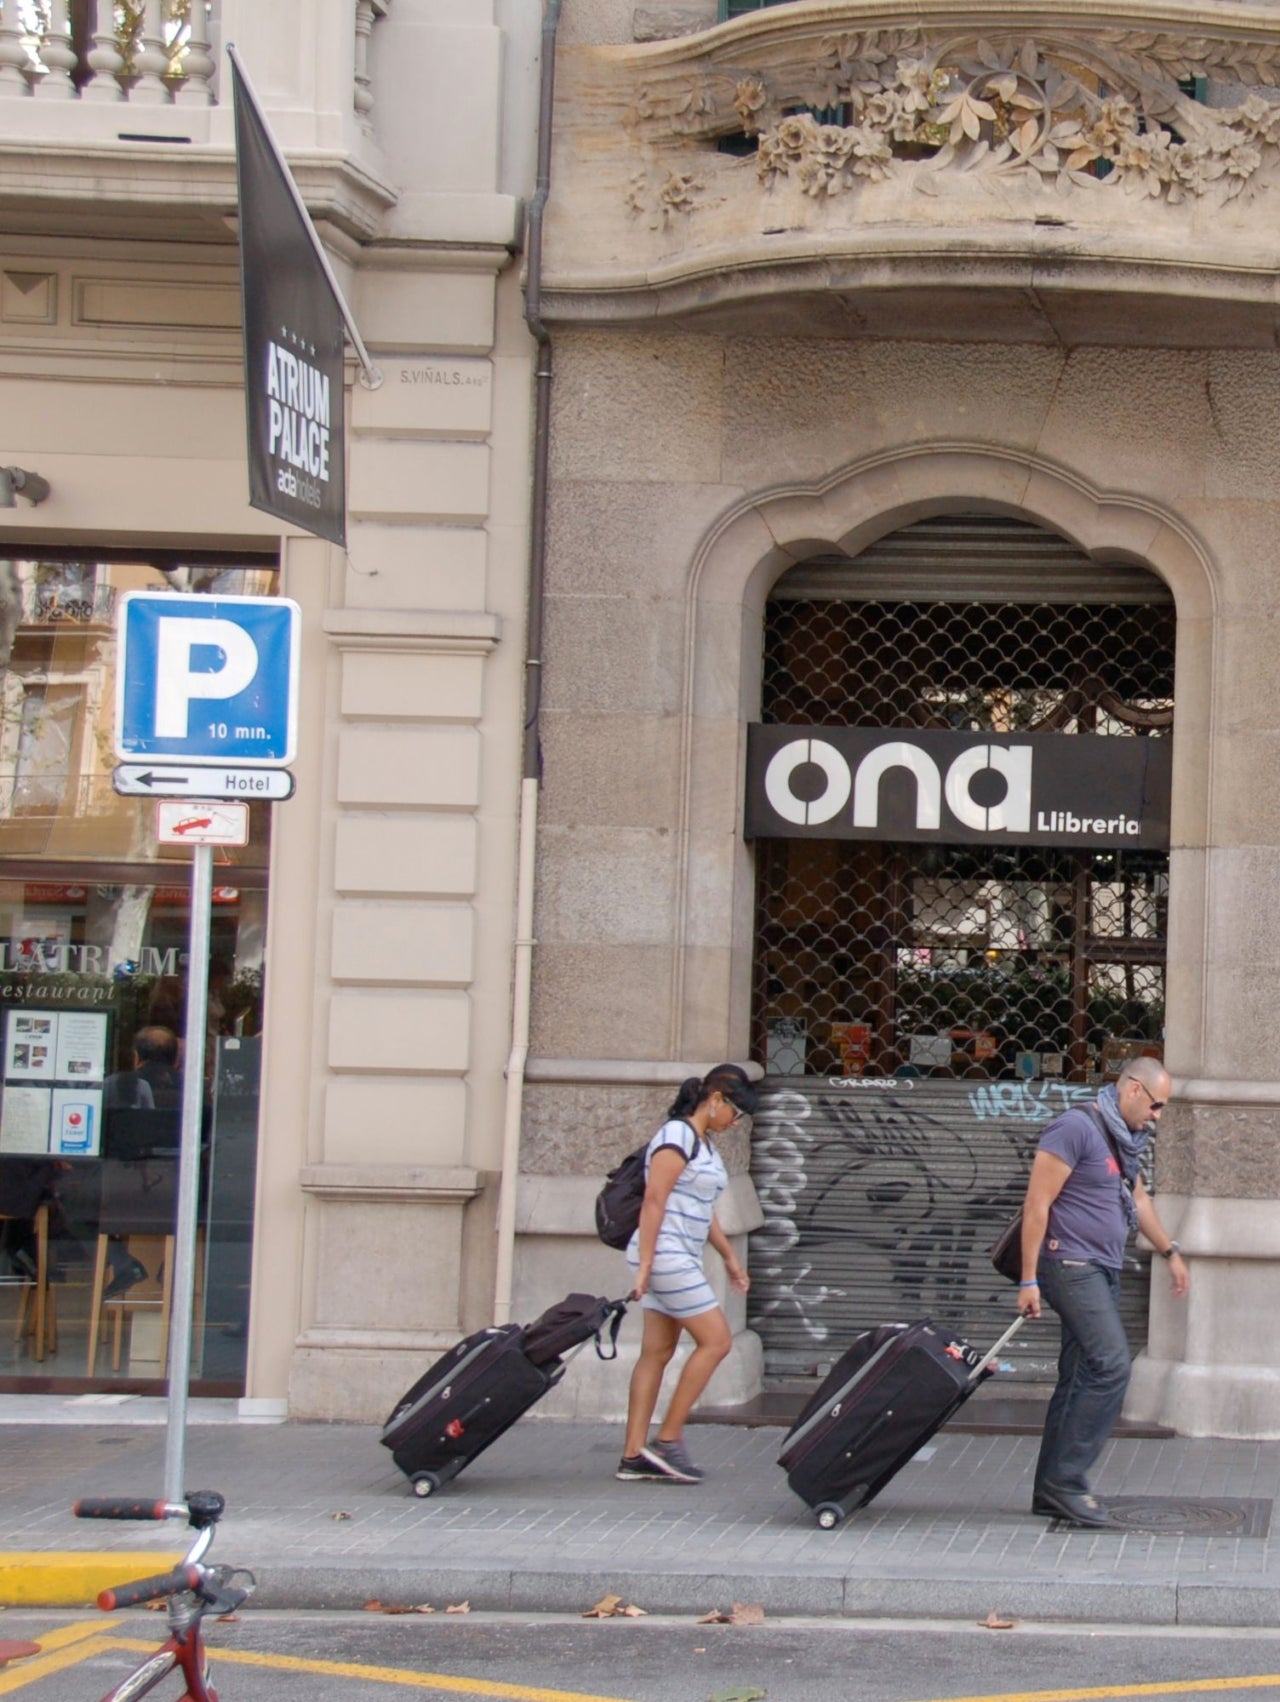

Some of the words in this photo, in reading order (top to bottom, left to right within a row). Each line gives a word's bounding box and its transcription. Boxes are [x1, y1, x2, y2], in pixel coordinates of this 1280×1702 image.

[267, 341, 330, 429] ATRIUM
[269, 398, 330, 482] PALACE
[155, 616, 259, 738] P
[209, 723, 228, 738] 10
[225, 775, 270, 791] Hotel
[764, 738, 1033, 833] ona
[1037, 811, 1141, 835] Llibreria
[0, 982, 116, 1001] estaurant
